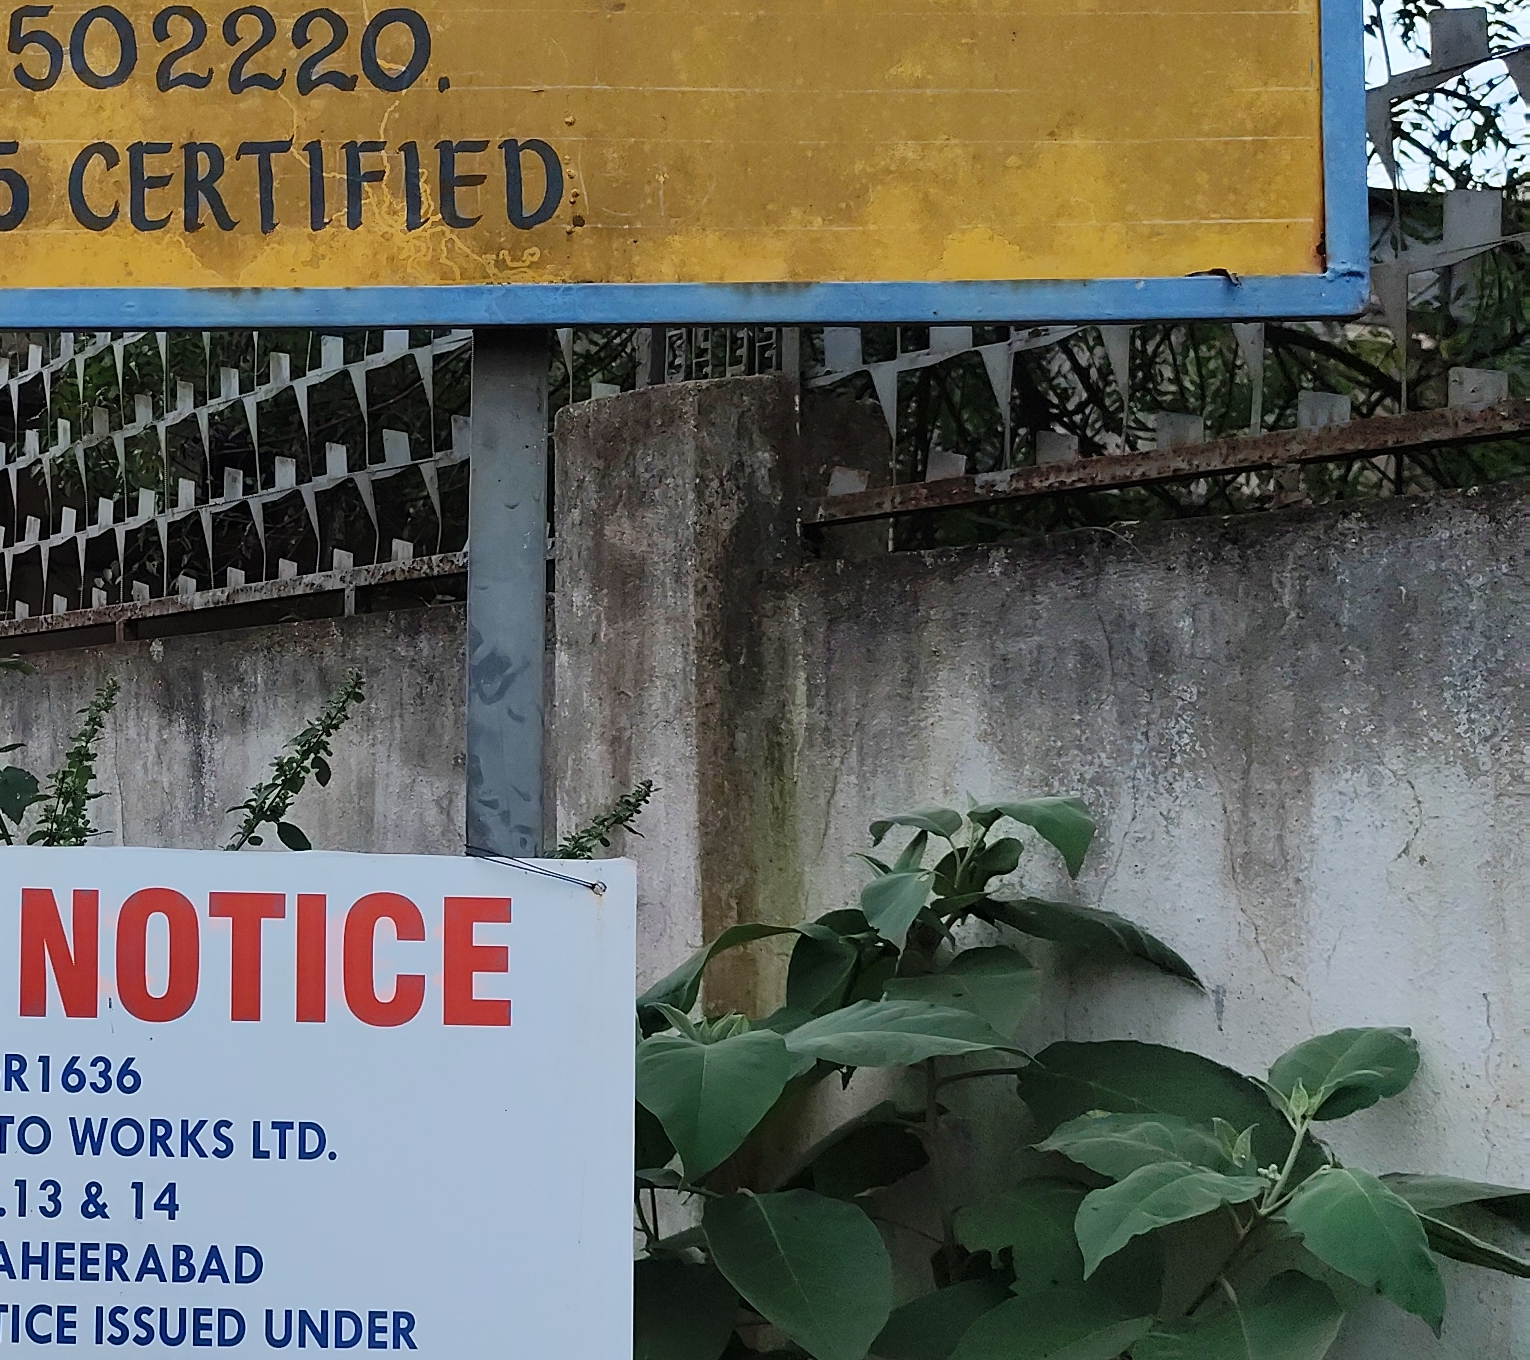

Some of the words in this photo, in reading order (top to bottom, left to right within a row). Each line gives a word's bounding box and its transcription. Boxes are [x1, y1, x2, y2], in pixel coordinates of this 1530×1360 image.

[20, 887, 512, 1027] NOTICE
[69, 1117, 234, 1159] WORKS
[252, 1121, 337, 1160] LTD.
[81, 1181, 109, 1219] &
[131, 1181, 179, 1220] 14
[94, 1306, 245, 1347] ISSUED
[264, 1309, 418, 1349] UNDER
